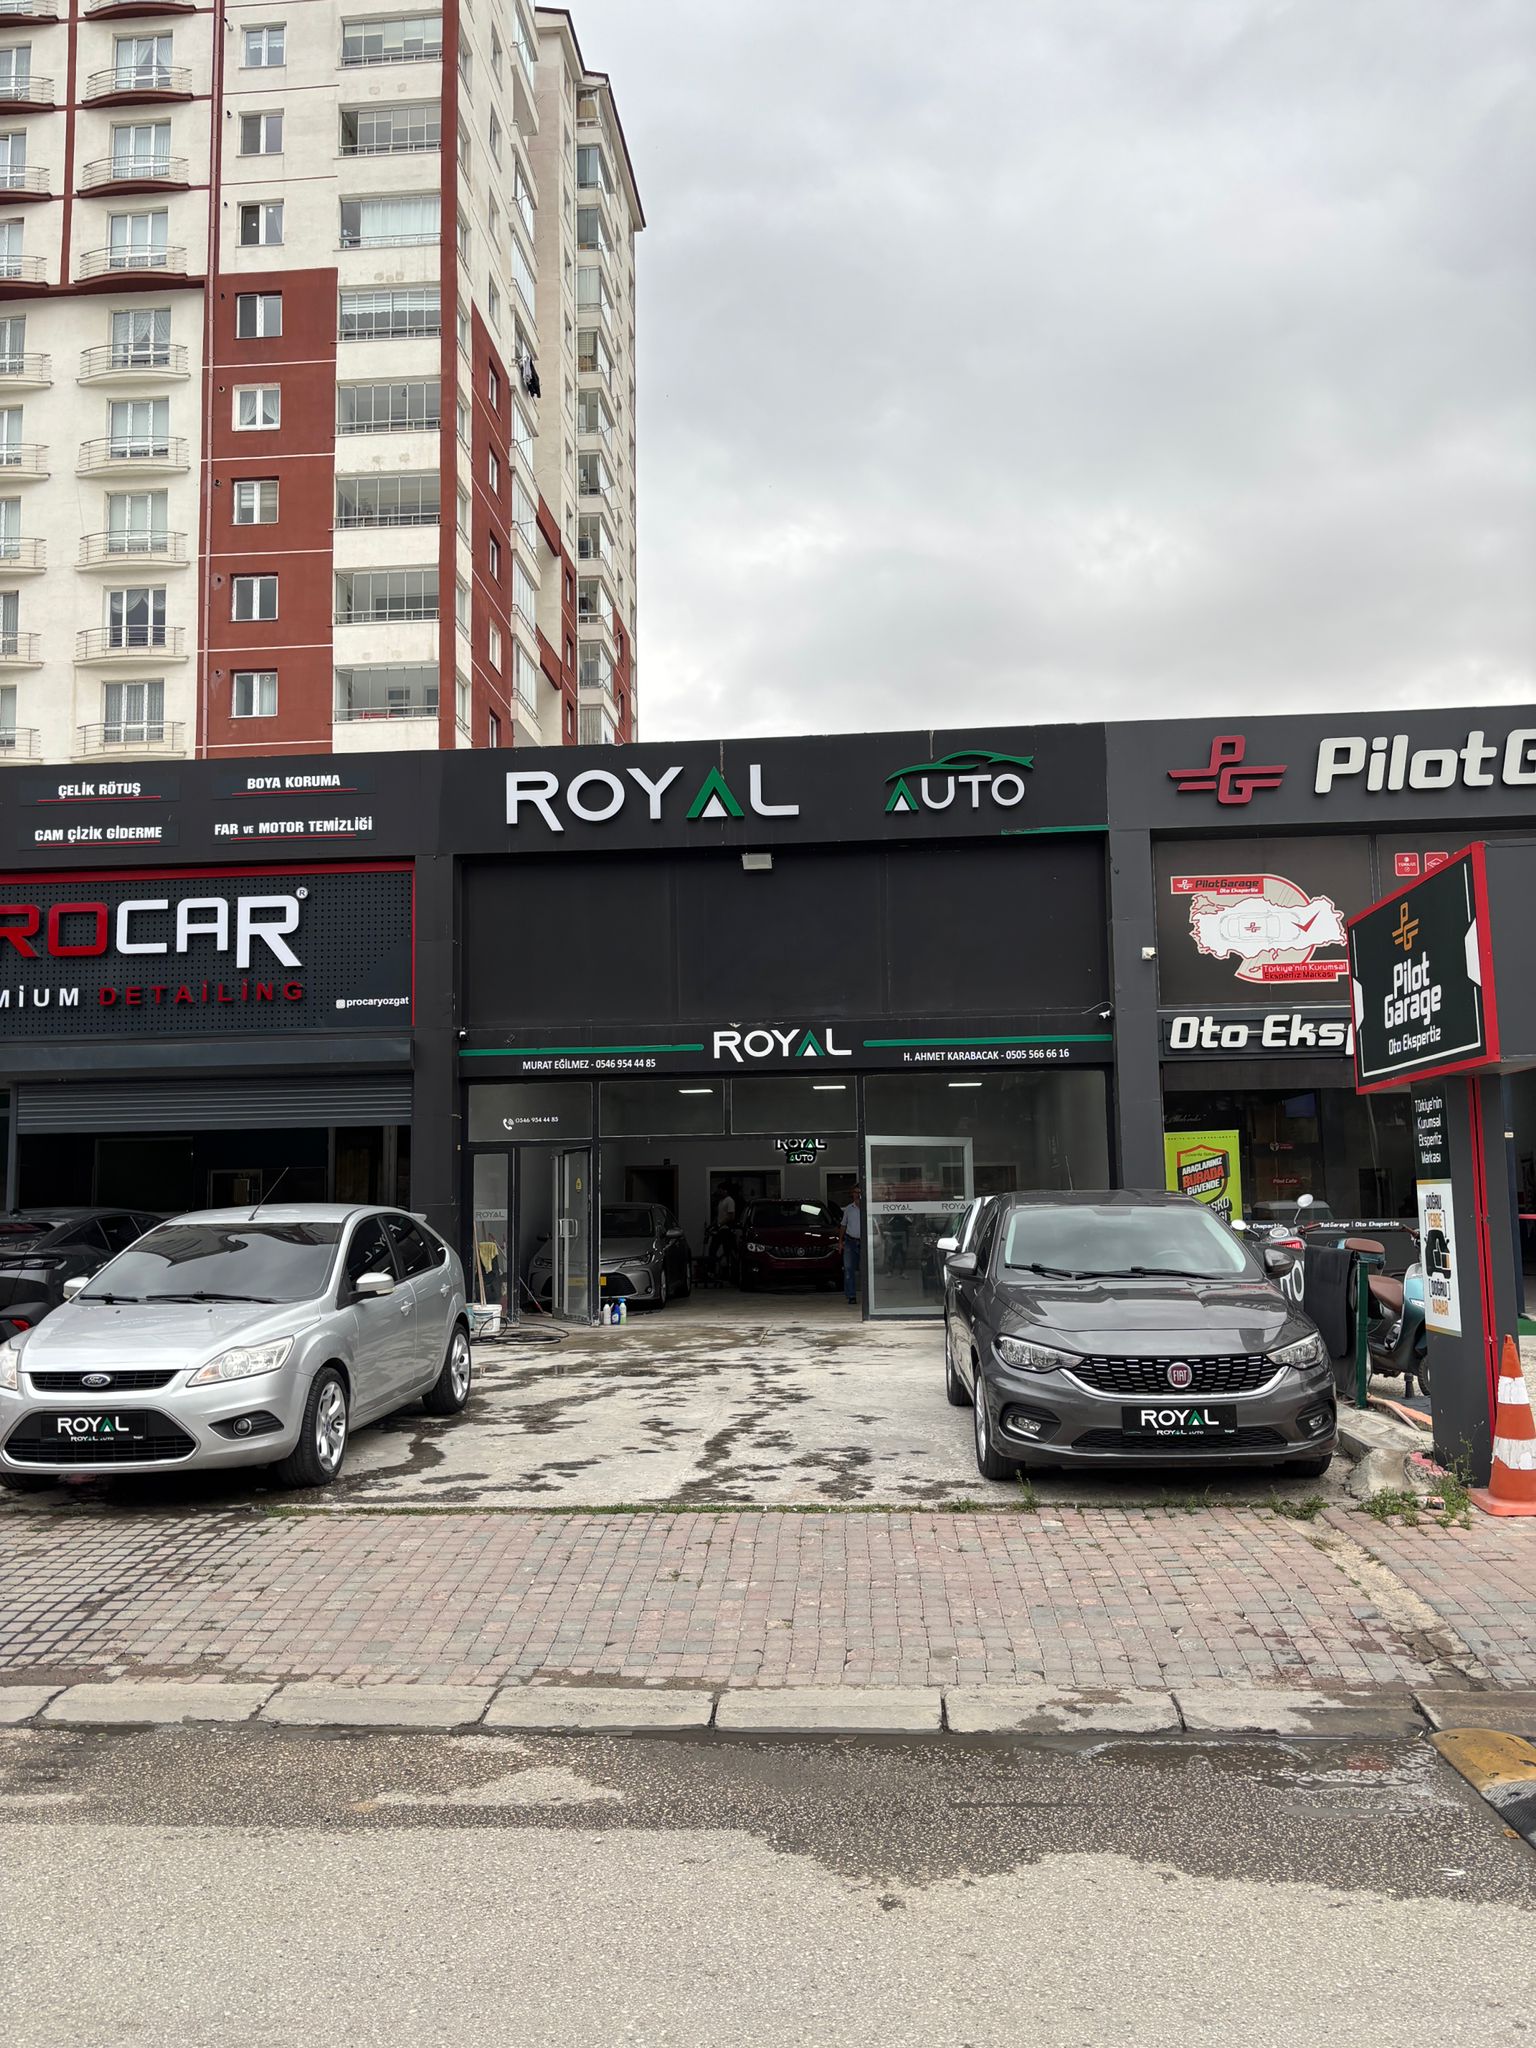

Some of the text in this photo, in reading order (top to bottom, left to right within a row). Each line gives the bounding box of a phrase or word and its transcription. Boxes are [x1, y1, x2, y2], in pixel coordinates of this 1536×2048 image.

[58, 781, 141, 800] ÇELİK RÖTUŞ
[247, 774, 341, 790] BOYA KORUMA
[506, 764, 800, 832] ROYAL
[884, 773, 1025, 813] AUTO
[34, 825, 162, 843] CAM ÇİZİK GİDERME
[214, 823, 239, 835] FAR
[258, 821, 304, 834] MOTOR
[308, 816, 373, 832] TEMİZLİĞİ
[1309, 962, 1346, 971] Kurumsal
[1393, 951, 1430, 999] Pilot
[98, 978, 303, 1006] DETAİLİNG
[346, 996, 409, 1008] procaryozgat
[1384, 985, 1442, 1029] Garage
[1170, 1016, 1249, 1049] Oto
[1388, 1025, 1441, 1055] Oto Ekspertiz
[713, 1028, 852, 1062] ROYAL
[903, 1052, 913, 1061] H.
[914, 1051, 946, 1061] AHMET
[947, 1050, 999, 1060] KARABACAK
[1005, 1050, 1026, 1059] 0505
[1028, 1049, 1045, 1058] 566
[1046, 1049, 1057, 1058] 66
[1059, 1048, 1070, 1058] 16
[522, 1061, 553, 1070] MURAT
[554, 1058, 589, 1070] EĞİLMEZ
[595, 1060, 616, 1069] 0546
[617, 1060, 632, 1068] 954
[633, 1060, 645, 1068] 44
[646, 1059, 656, 1068] 85
[1183, 1165, 1225, 1188] BURADA
[475, 1211, 505, 1219] ROYAL
[883, 1204, 912, 1212] ROYAL
[1173, 1370, 1187, 1381] FIAT
[57, 1416, 130, 1436] ROYAL
[1141, 1409, 1219, 1429] ROYAL
